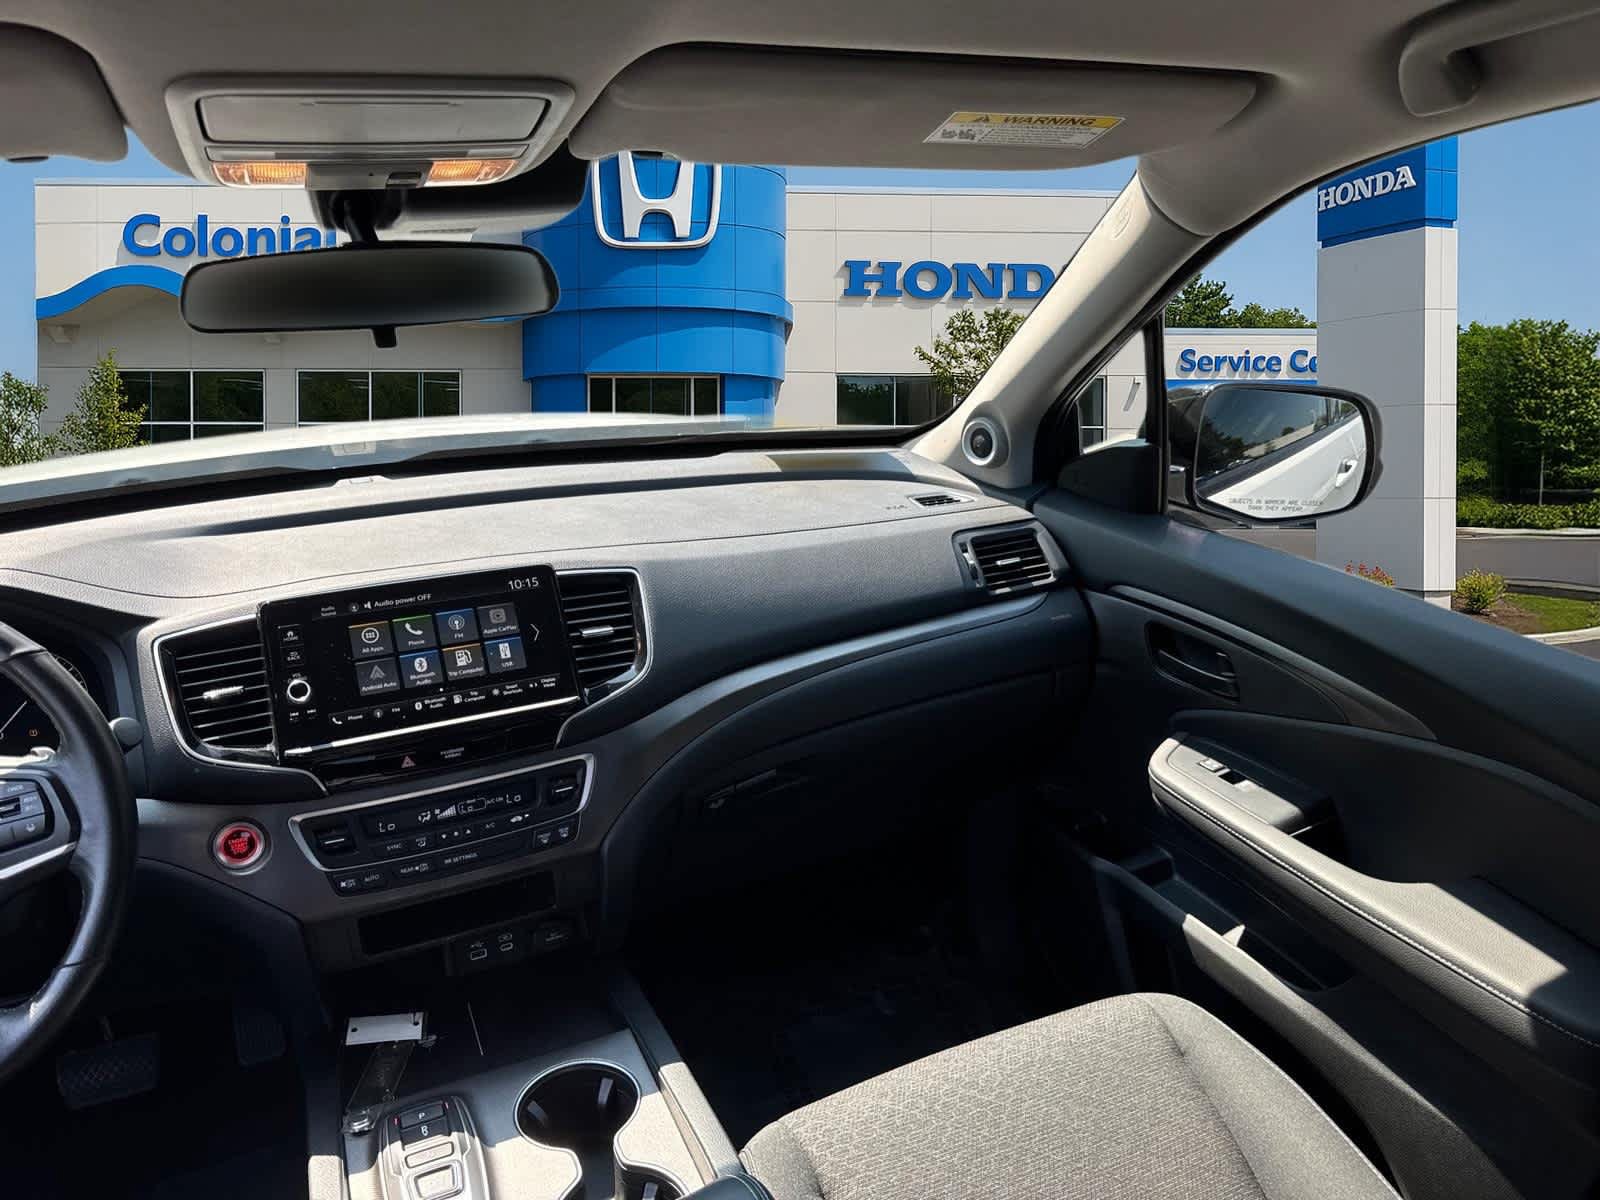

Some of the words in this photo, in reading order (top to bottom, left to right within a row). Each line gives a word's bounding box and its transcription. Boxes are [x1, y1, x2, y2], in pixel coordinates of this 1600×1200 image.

[1003, 115, 1096, 127] WARNING
[1318, 166, 1417, 212] HONDA
[843, 260, 1057, 299] HOND
[1180, 348, 1282, 373] Service
[508, 577, 539, 590] 10:15
[395, 596, 416, 605] power
[417, 593, 432, 601] OFF
